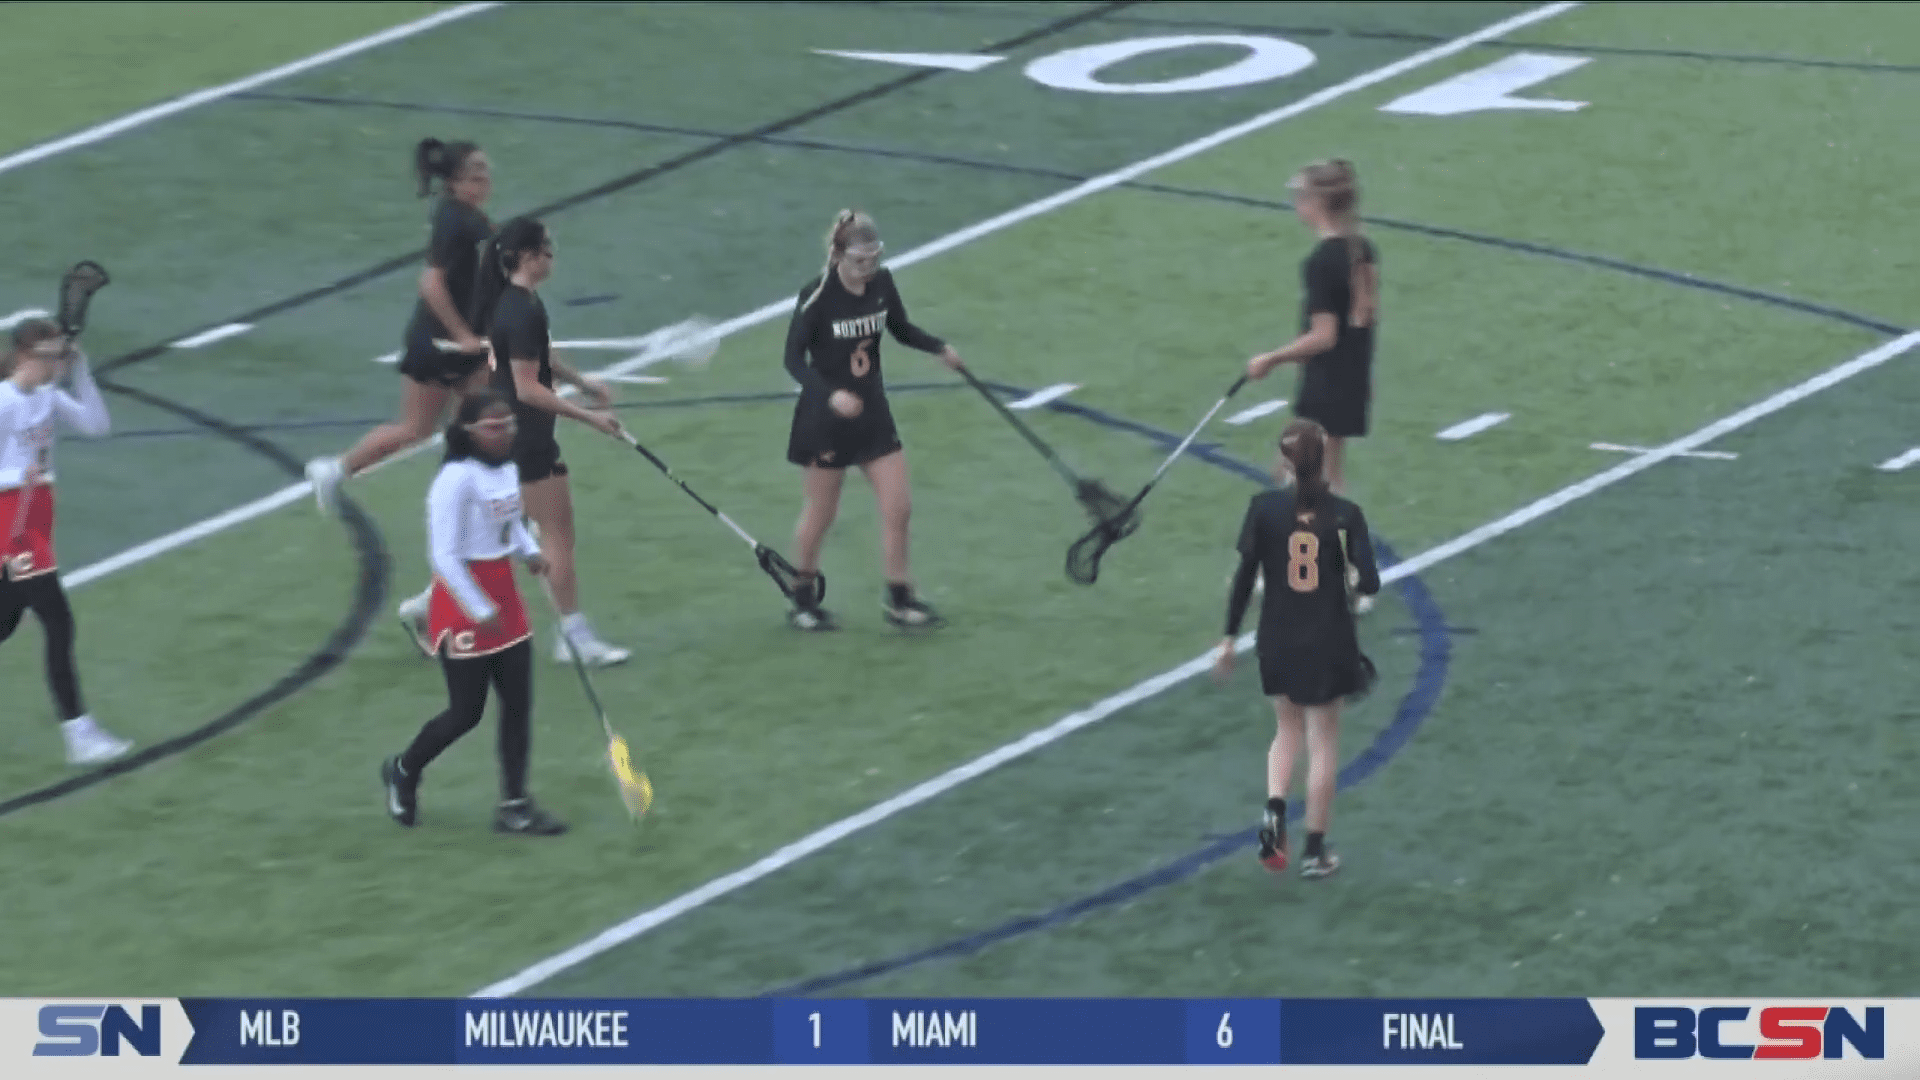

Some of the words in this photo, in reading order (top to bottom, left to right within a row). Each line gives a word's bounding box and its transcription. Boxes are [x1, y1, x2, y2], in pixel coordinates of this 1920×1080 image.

[850, 338, 873, 377] 6
[1288, 531, 1319, 592] 8
[455, 630, 475, 650] C
